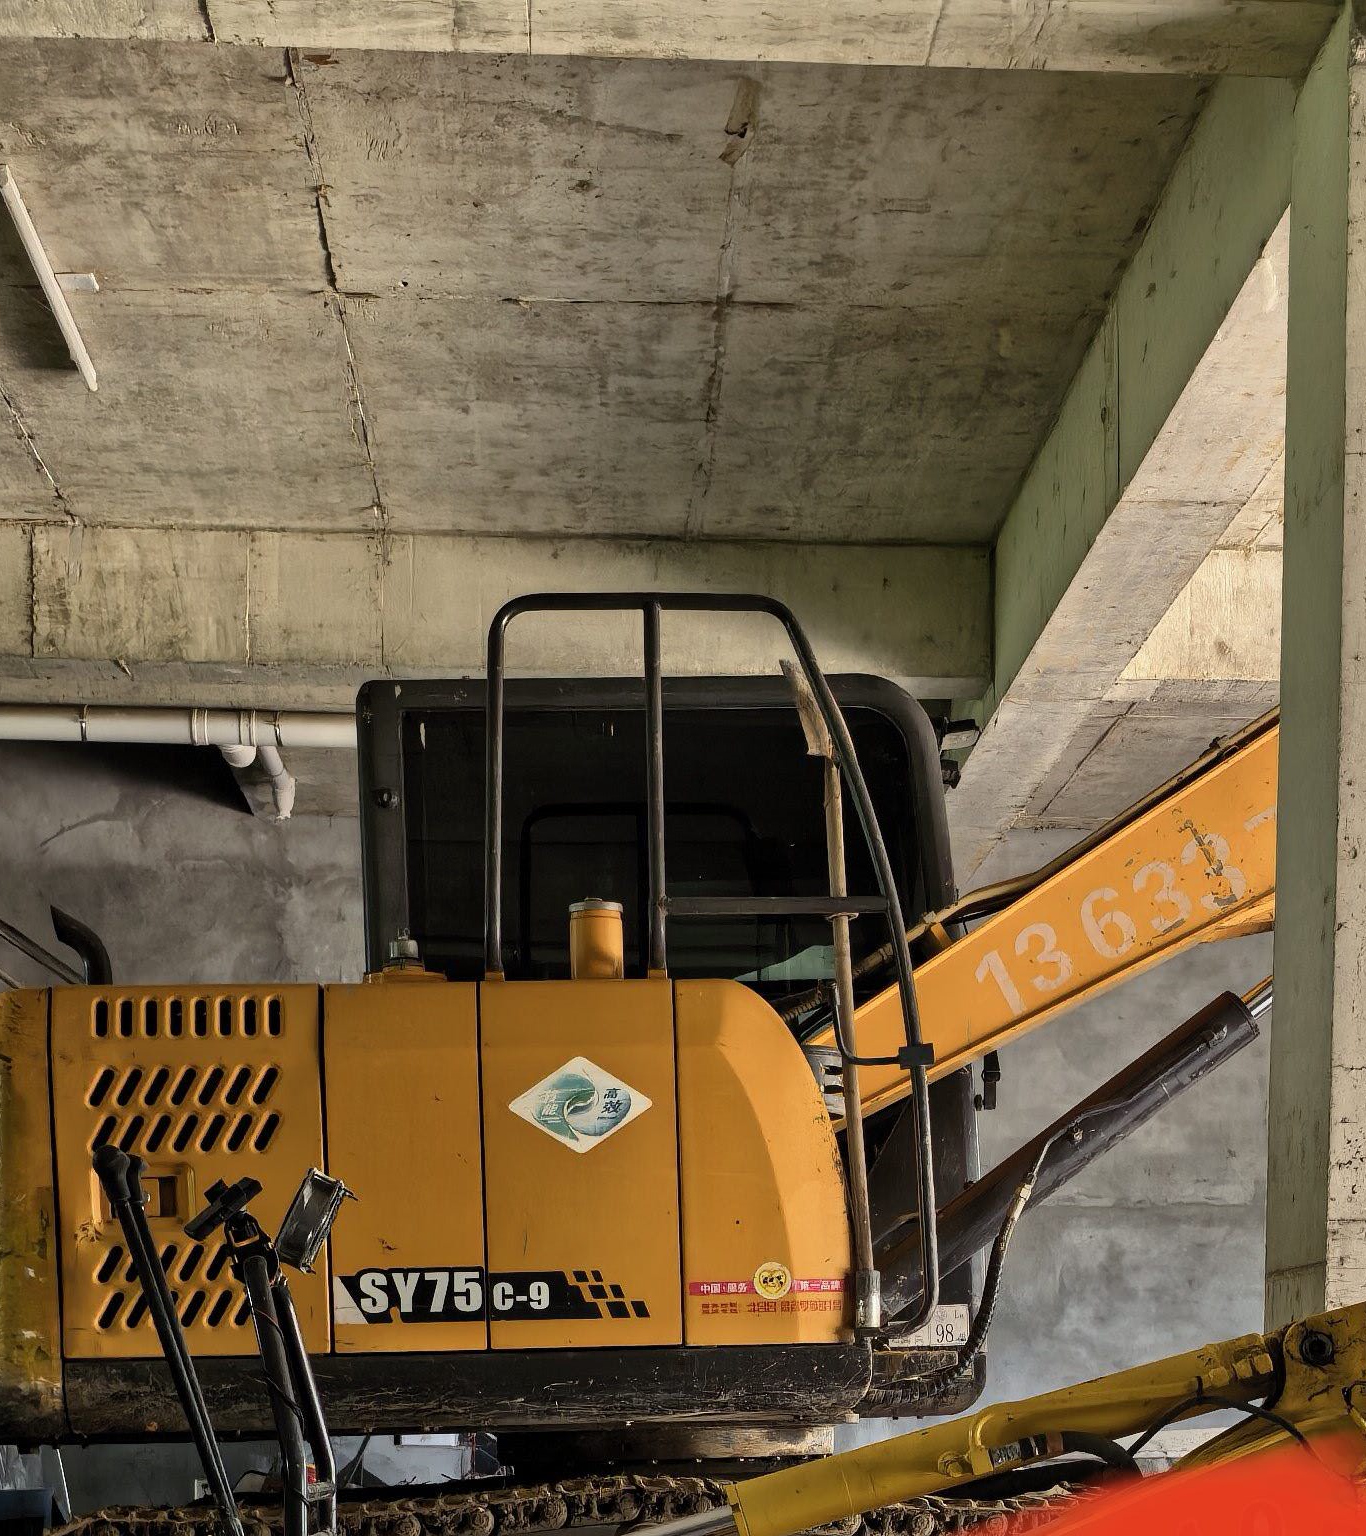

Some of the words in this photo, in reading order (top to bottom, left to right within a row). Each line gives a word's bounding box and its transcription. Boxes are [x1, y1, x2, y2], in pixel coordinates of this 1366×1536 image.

[975, 807, 1276, 1016] 13633
[601, 1088, 622, 1113] 高效
[359, 1272, 483, 1314] SY75
[936, 1323, 954, 1343] 98
